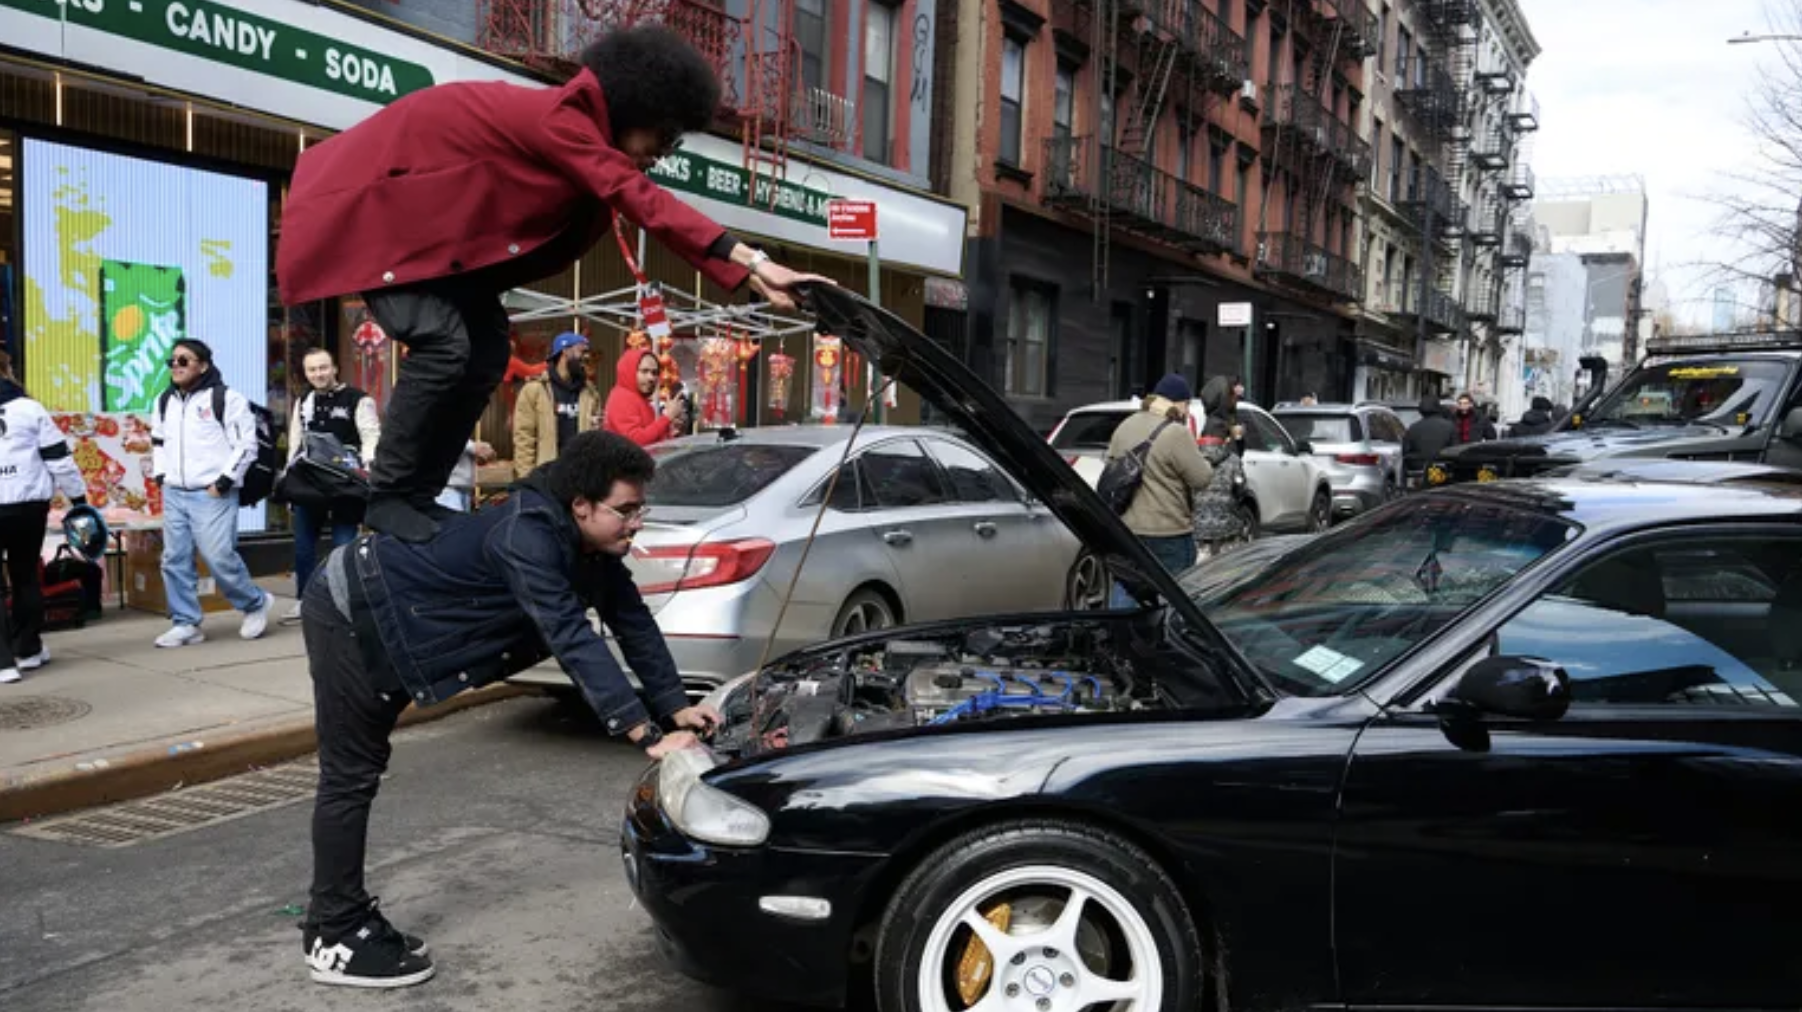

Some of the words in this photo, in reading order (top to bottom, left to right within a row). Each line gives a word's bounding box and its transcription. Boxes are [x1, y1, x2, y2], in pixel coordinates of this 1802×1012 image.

[165, 2, 276, 60] CANDY
[325, 47, 397, 95] SODA
[707, 165, 741, 197] BEER
